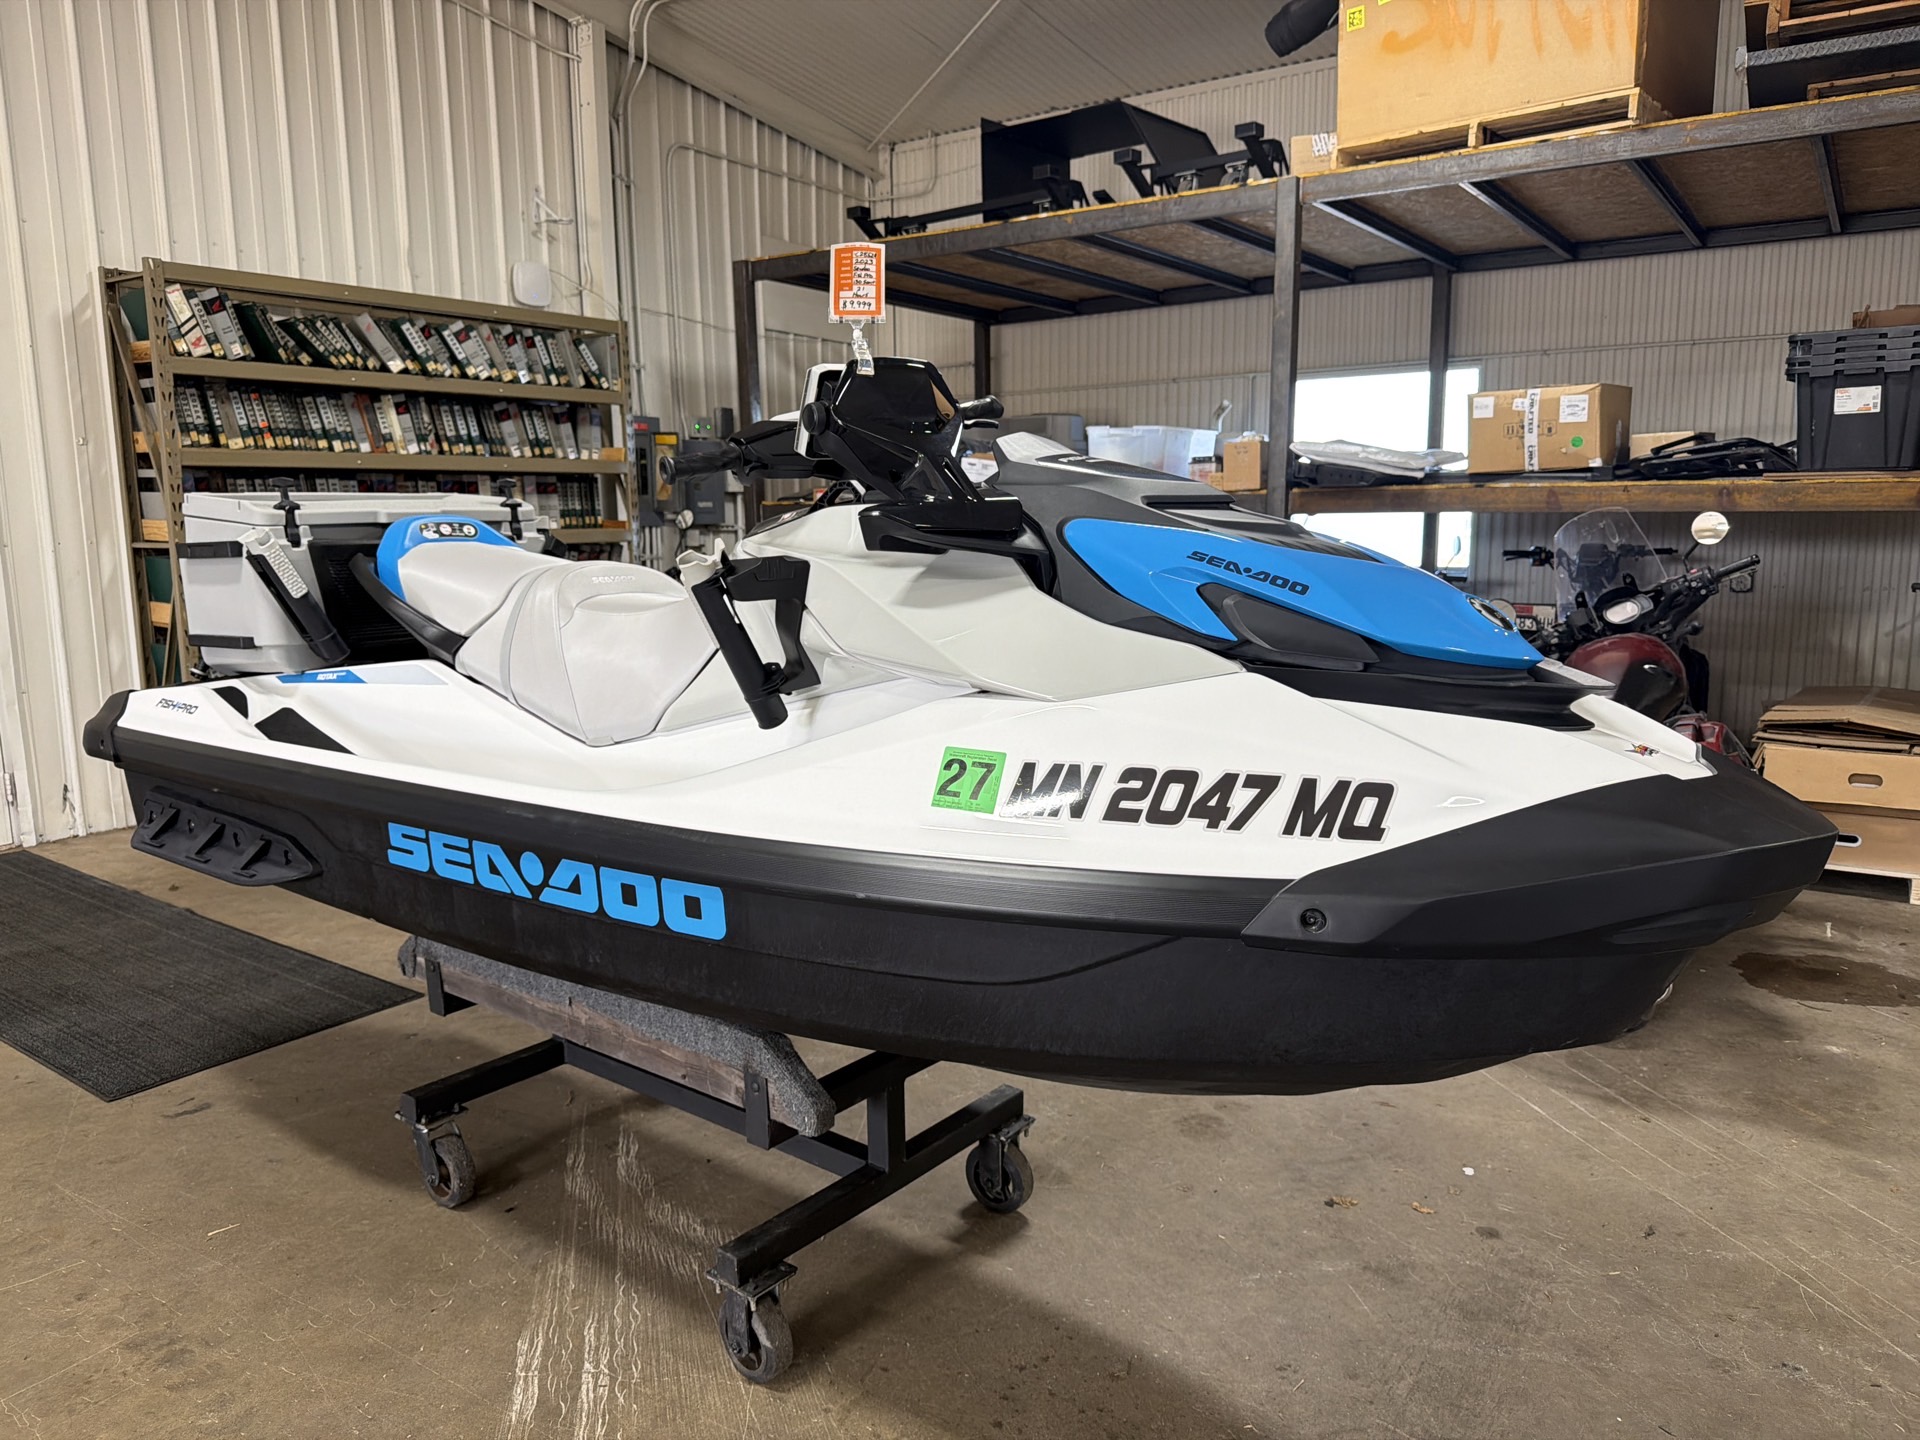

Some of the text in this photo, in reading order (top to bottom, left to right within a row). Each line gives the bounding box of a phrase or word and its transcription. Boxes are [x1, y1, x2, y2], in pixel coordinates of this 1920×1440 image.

[937, 758, 996, 800] 27
[1003, 761, 1102, 820] MN
[1102, 766, 1282, 832] 2047
[1282, 777, 1396, 843] MQ
